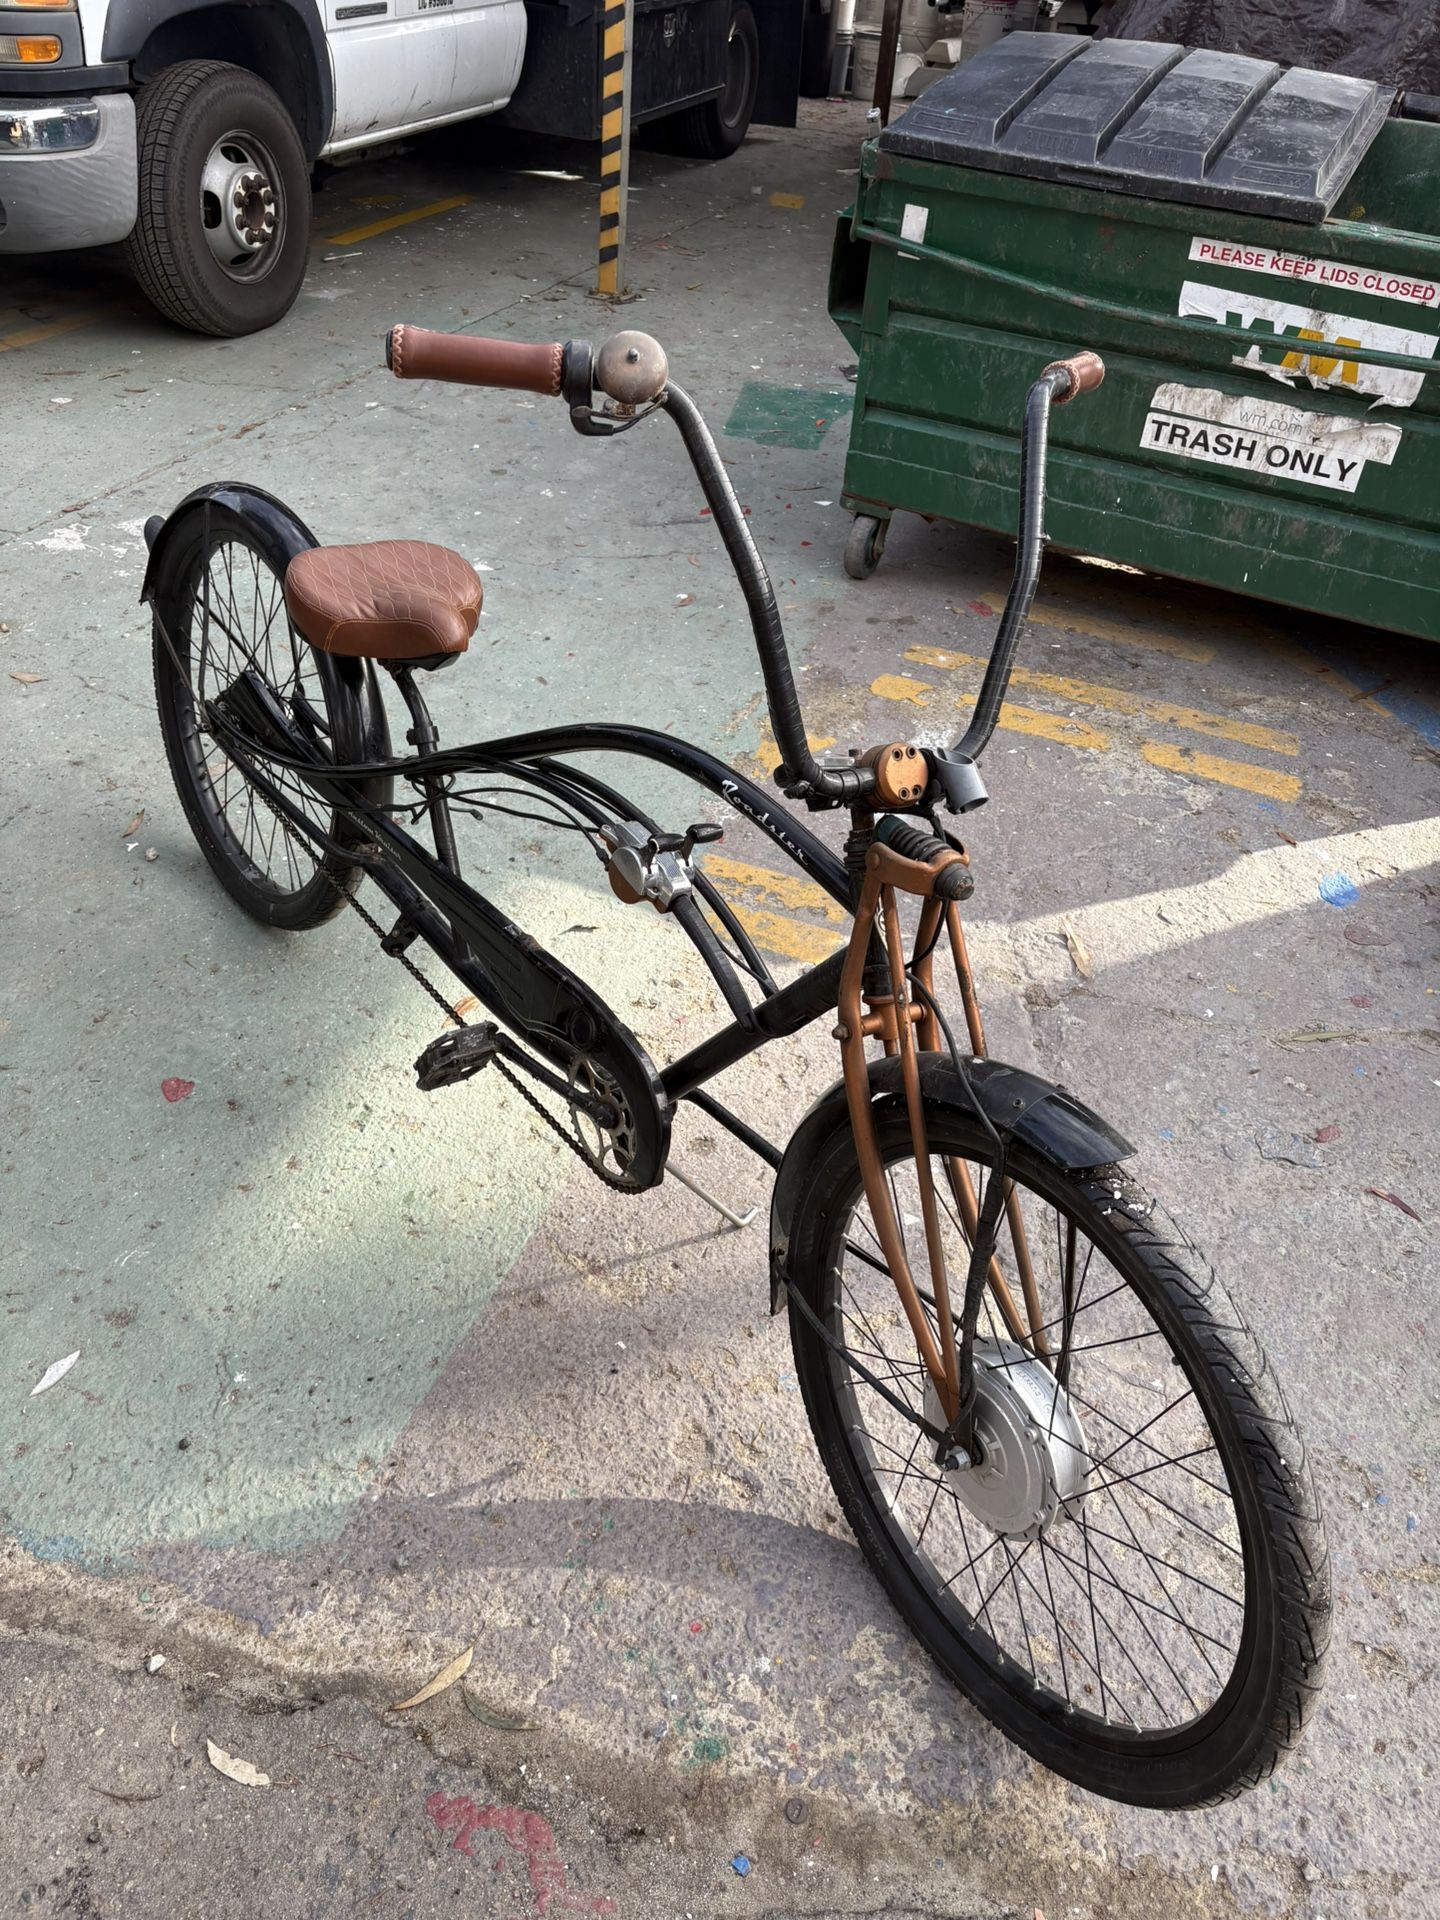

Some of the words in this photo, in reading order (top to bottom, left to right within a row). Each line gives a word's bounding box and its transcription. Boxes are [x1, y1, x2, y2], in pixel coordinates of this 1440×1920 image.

[1199, 244, 1266, 268] PLEASE
[1270, 256, 1316, 276] KEEP
[1319, 266, 1359, 286] LIDS
[1363, 275, 1436, 302] CLOSED
[1151, 419, 1258, 461] TRASH
[1265, 444, 1357, 482] ONLY
[1239, 411, 1303, 435] wm.com
[721, 779, 808, 865] Roadster
